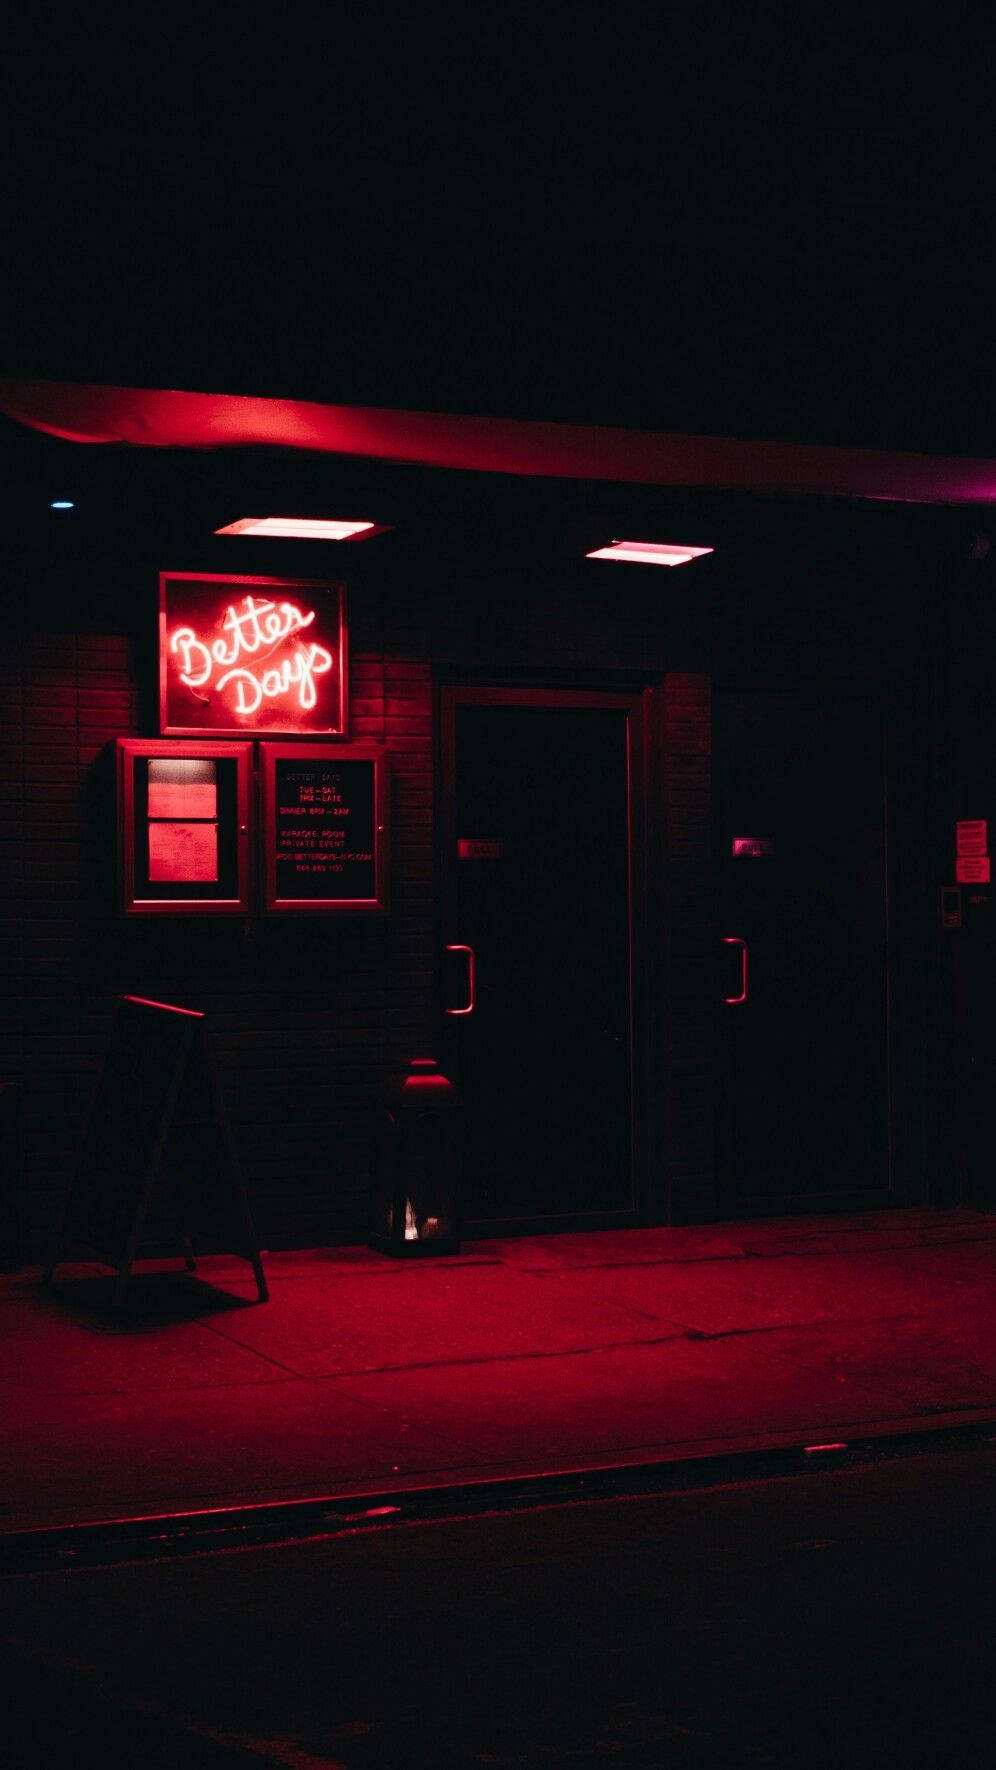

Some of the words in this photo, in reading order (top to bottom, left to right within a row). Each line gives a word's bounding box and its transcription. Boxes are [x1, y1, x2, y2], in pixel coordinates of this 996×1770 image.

[171, 595, 315, 686] Better
[216, 643, 333, 714] Days
[280, 840, 315, 848] PRIVATE
[318, 840, 345, 848] EVENT
[321, 830, 345, 838] ROOM
